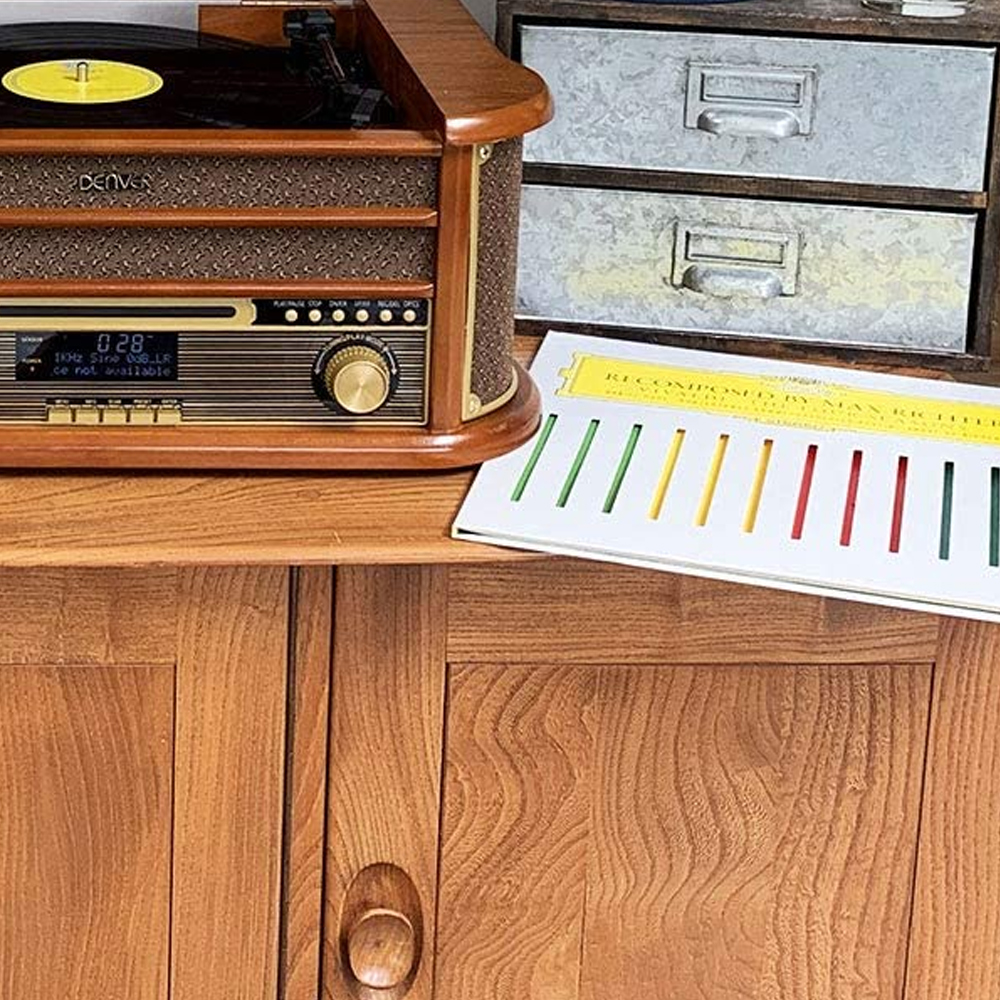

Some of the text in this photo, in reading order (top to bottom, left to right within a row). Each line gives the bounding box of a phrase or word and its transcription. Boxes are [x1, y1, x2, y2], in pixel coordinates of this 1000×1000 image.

[80, 173, 153, 190] DENVER
[97, 333, 144, 353] 028
[105, 365, 172, 377] available
